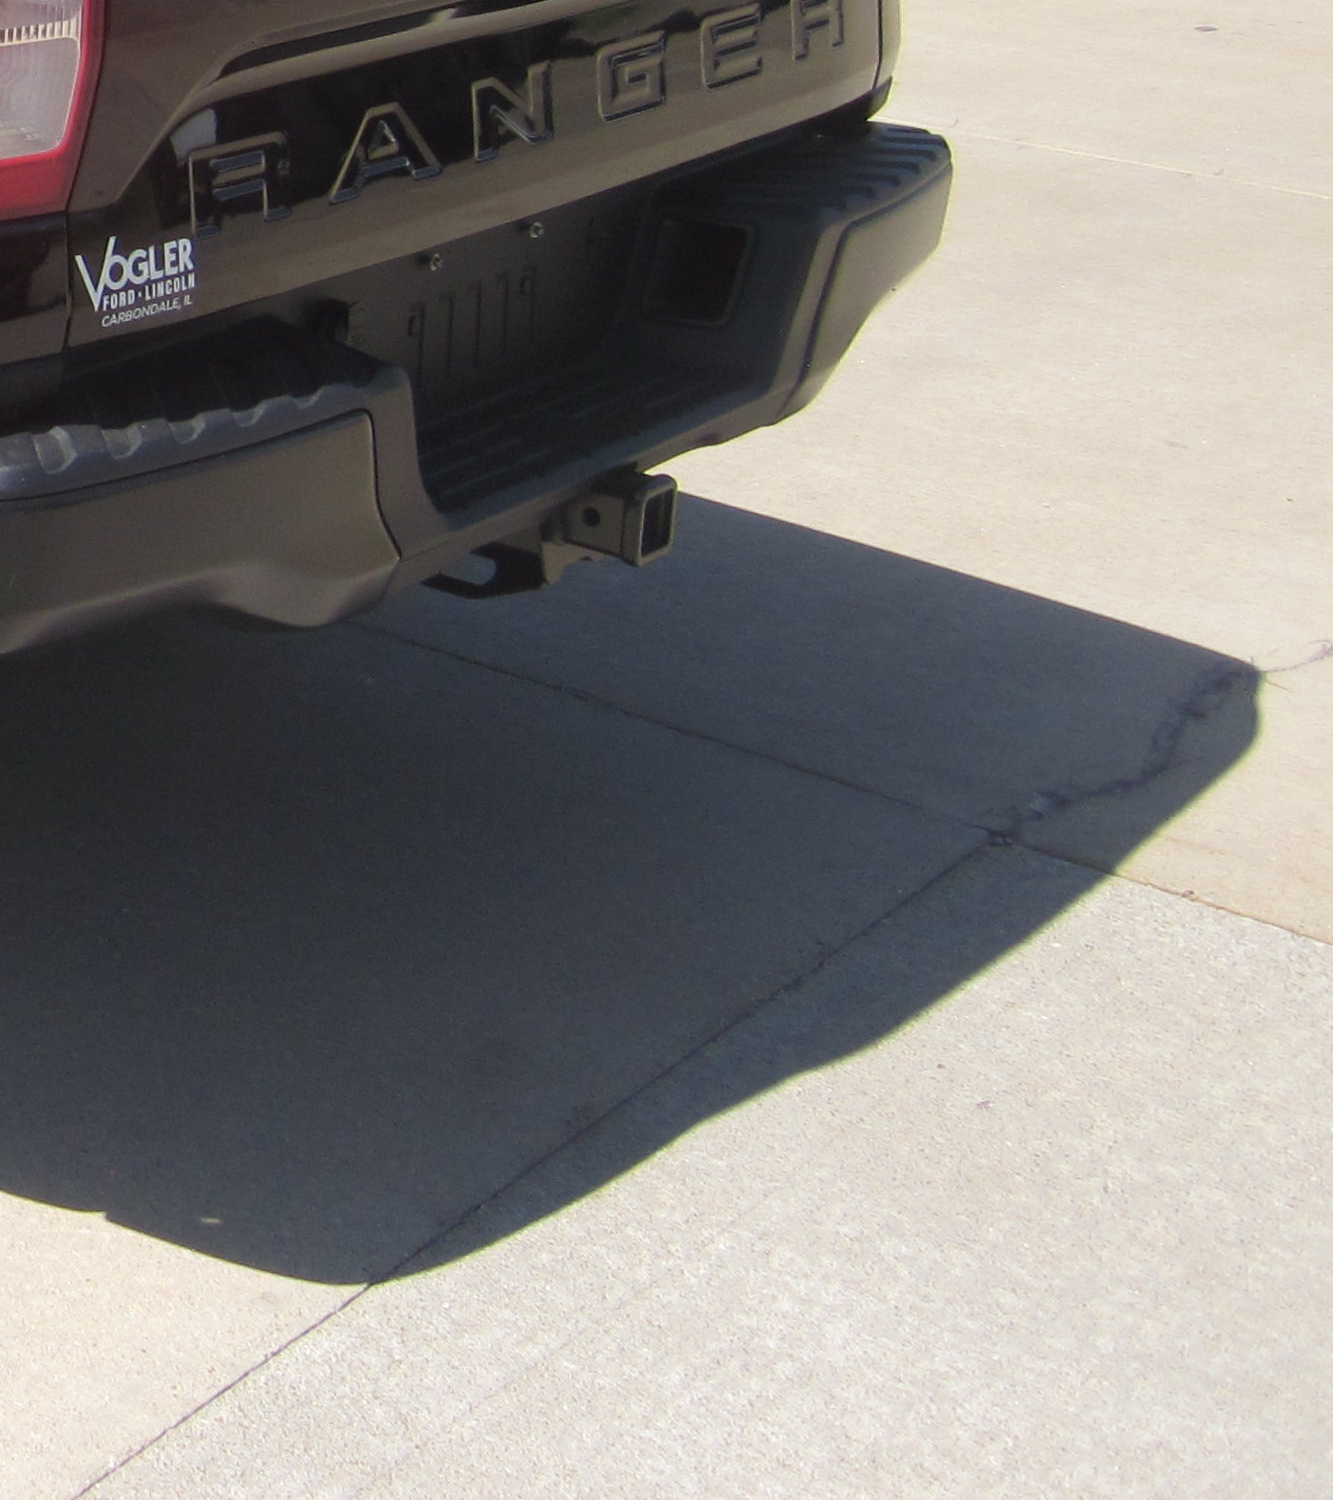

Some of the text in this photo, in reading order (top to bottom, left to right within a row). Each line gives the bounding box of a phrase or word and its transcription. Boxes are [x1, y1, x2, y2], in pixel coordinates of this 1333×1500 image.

[74, 235, 194, 312] VOGLER
[102, 272, 196, 312] FORD LINCOLN
